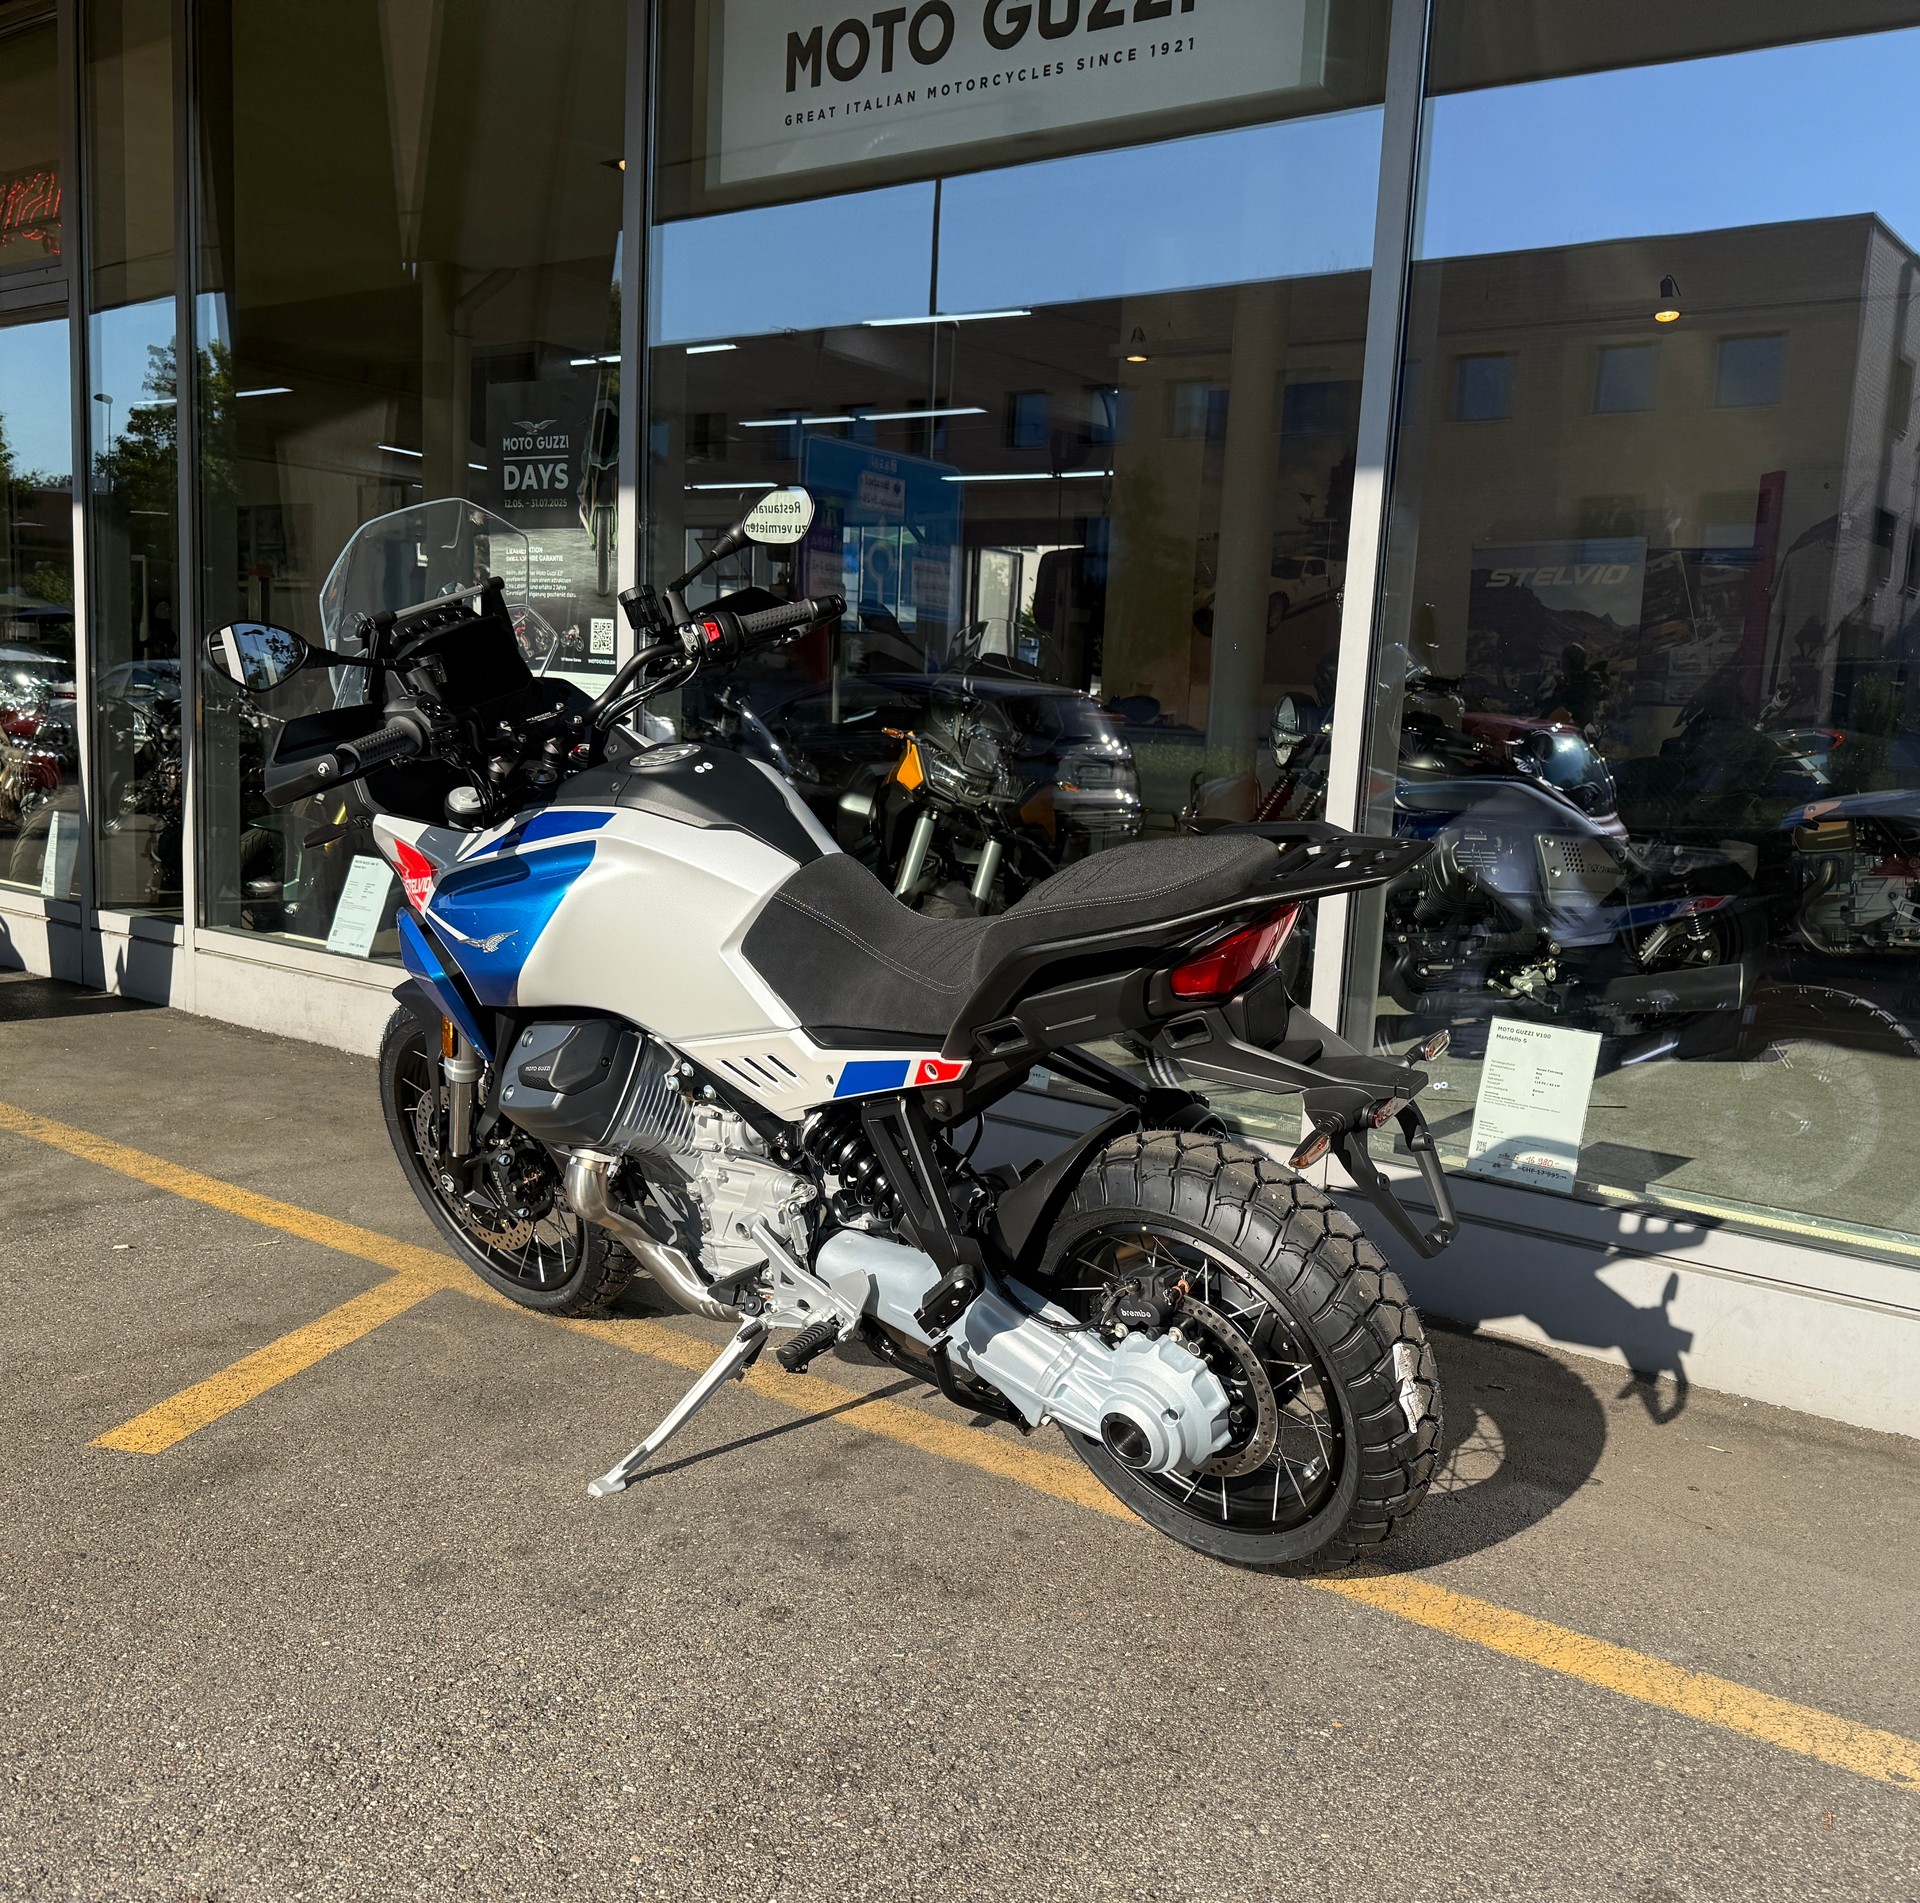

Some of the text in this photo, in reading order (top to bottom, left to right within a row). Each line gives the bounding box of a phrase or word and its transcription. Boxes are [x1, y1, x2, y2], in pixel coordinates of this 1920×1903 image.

[786, 0, 955, 93] MOTO
[784, 37, 1196, 126] GREAT ITALIAN MOTORCYCLES SINCE 1921
[503, 435, 569, 451] MOTO GUZZI
[503, 462, 569, 491] DAYS
[504, 499, 524, 508] 12.05.
[531, 498, 568, 508] 31.07.2025
[1485, 564, 1632, 588] STELVIO
[1497, 1026, 1552, 1040] MOTO GUZZI V100
[1120, 1308, 1152, 1318] brembo
